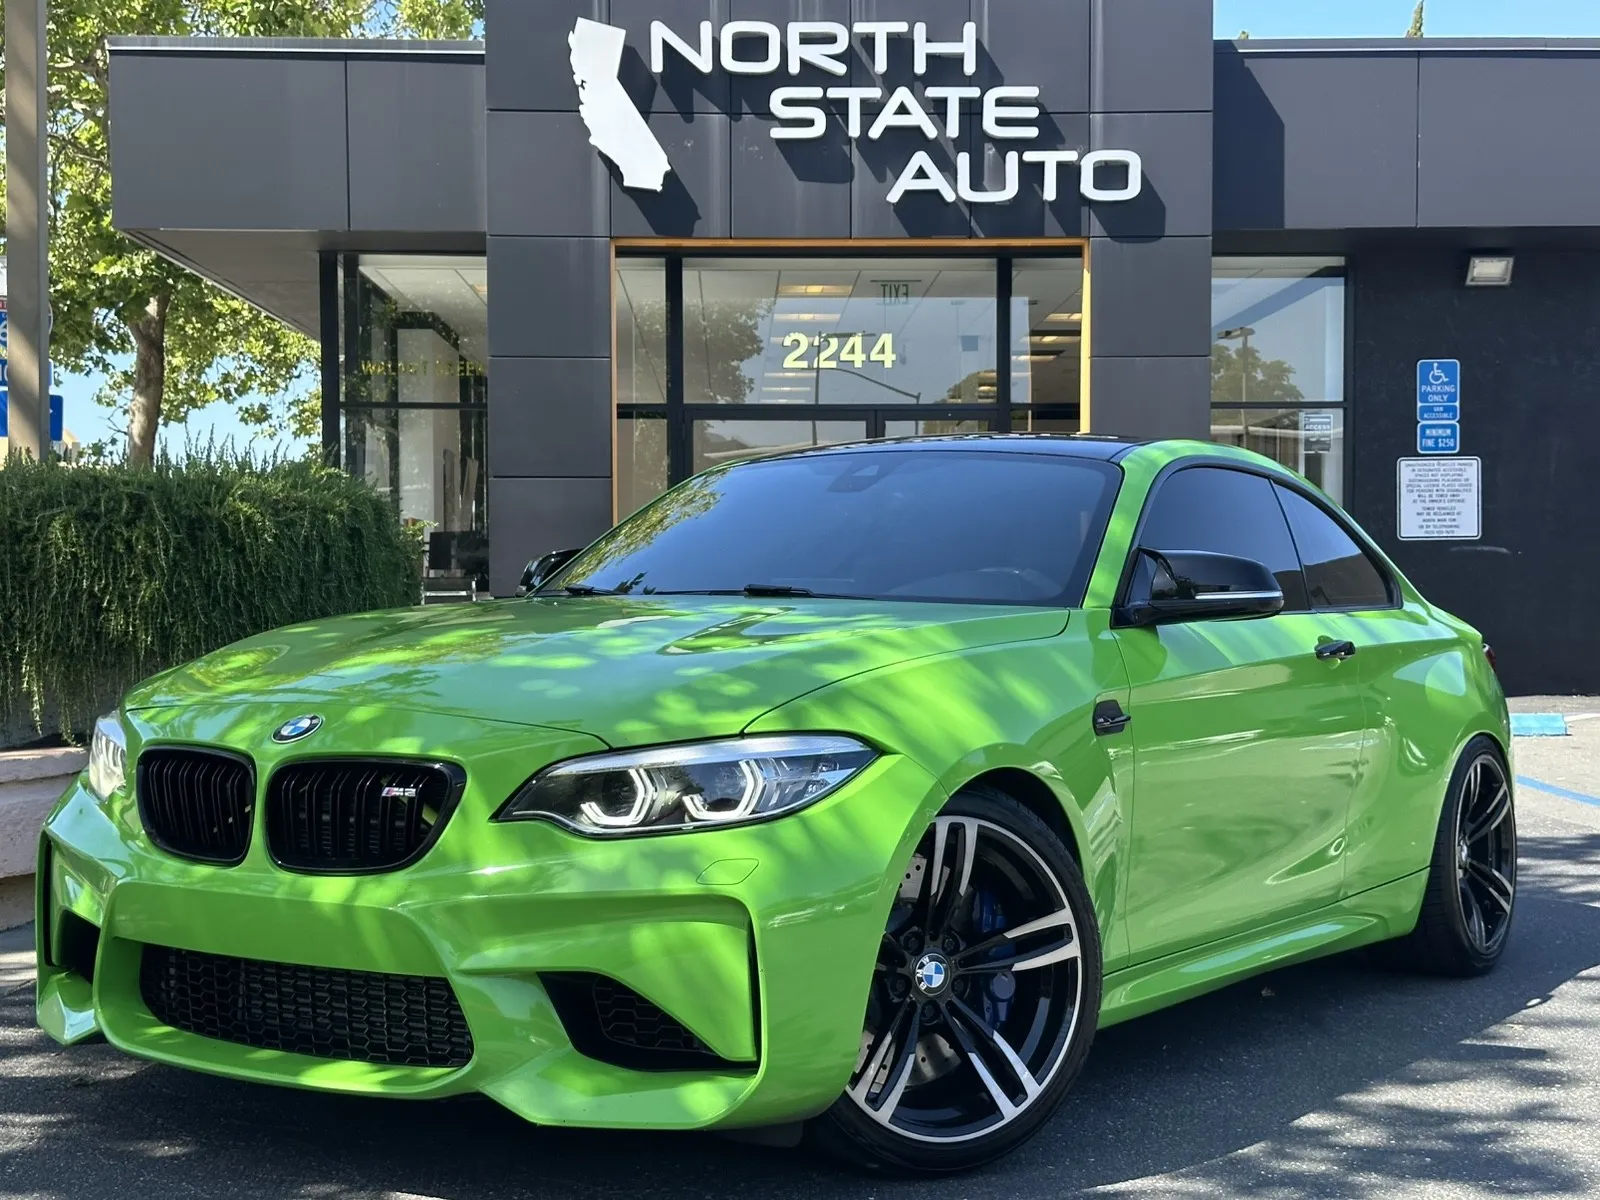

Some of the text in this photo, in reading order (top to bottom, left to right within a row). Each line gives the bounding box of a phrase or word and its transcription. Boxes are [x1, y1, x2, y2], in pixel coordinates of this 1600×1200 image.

[650, 20, 977, 76] NORTH
[769, 86, 1040, 140] STATE
[886, 149, 1143, 203] AUTO
[782, 331, 897, 369] 2244
[1421, 385, 1456, 393] PARKING
[1428, 394, 1449, 402] ONLY
[1421, 438, 1455, 447] FINE $250
